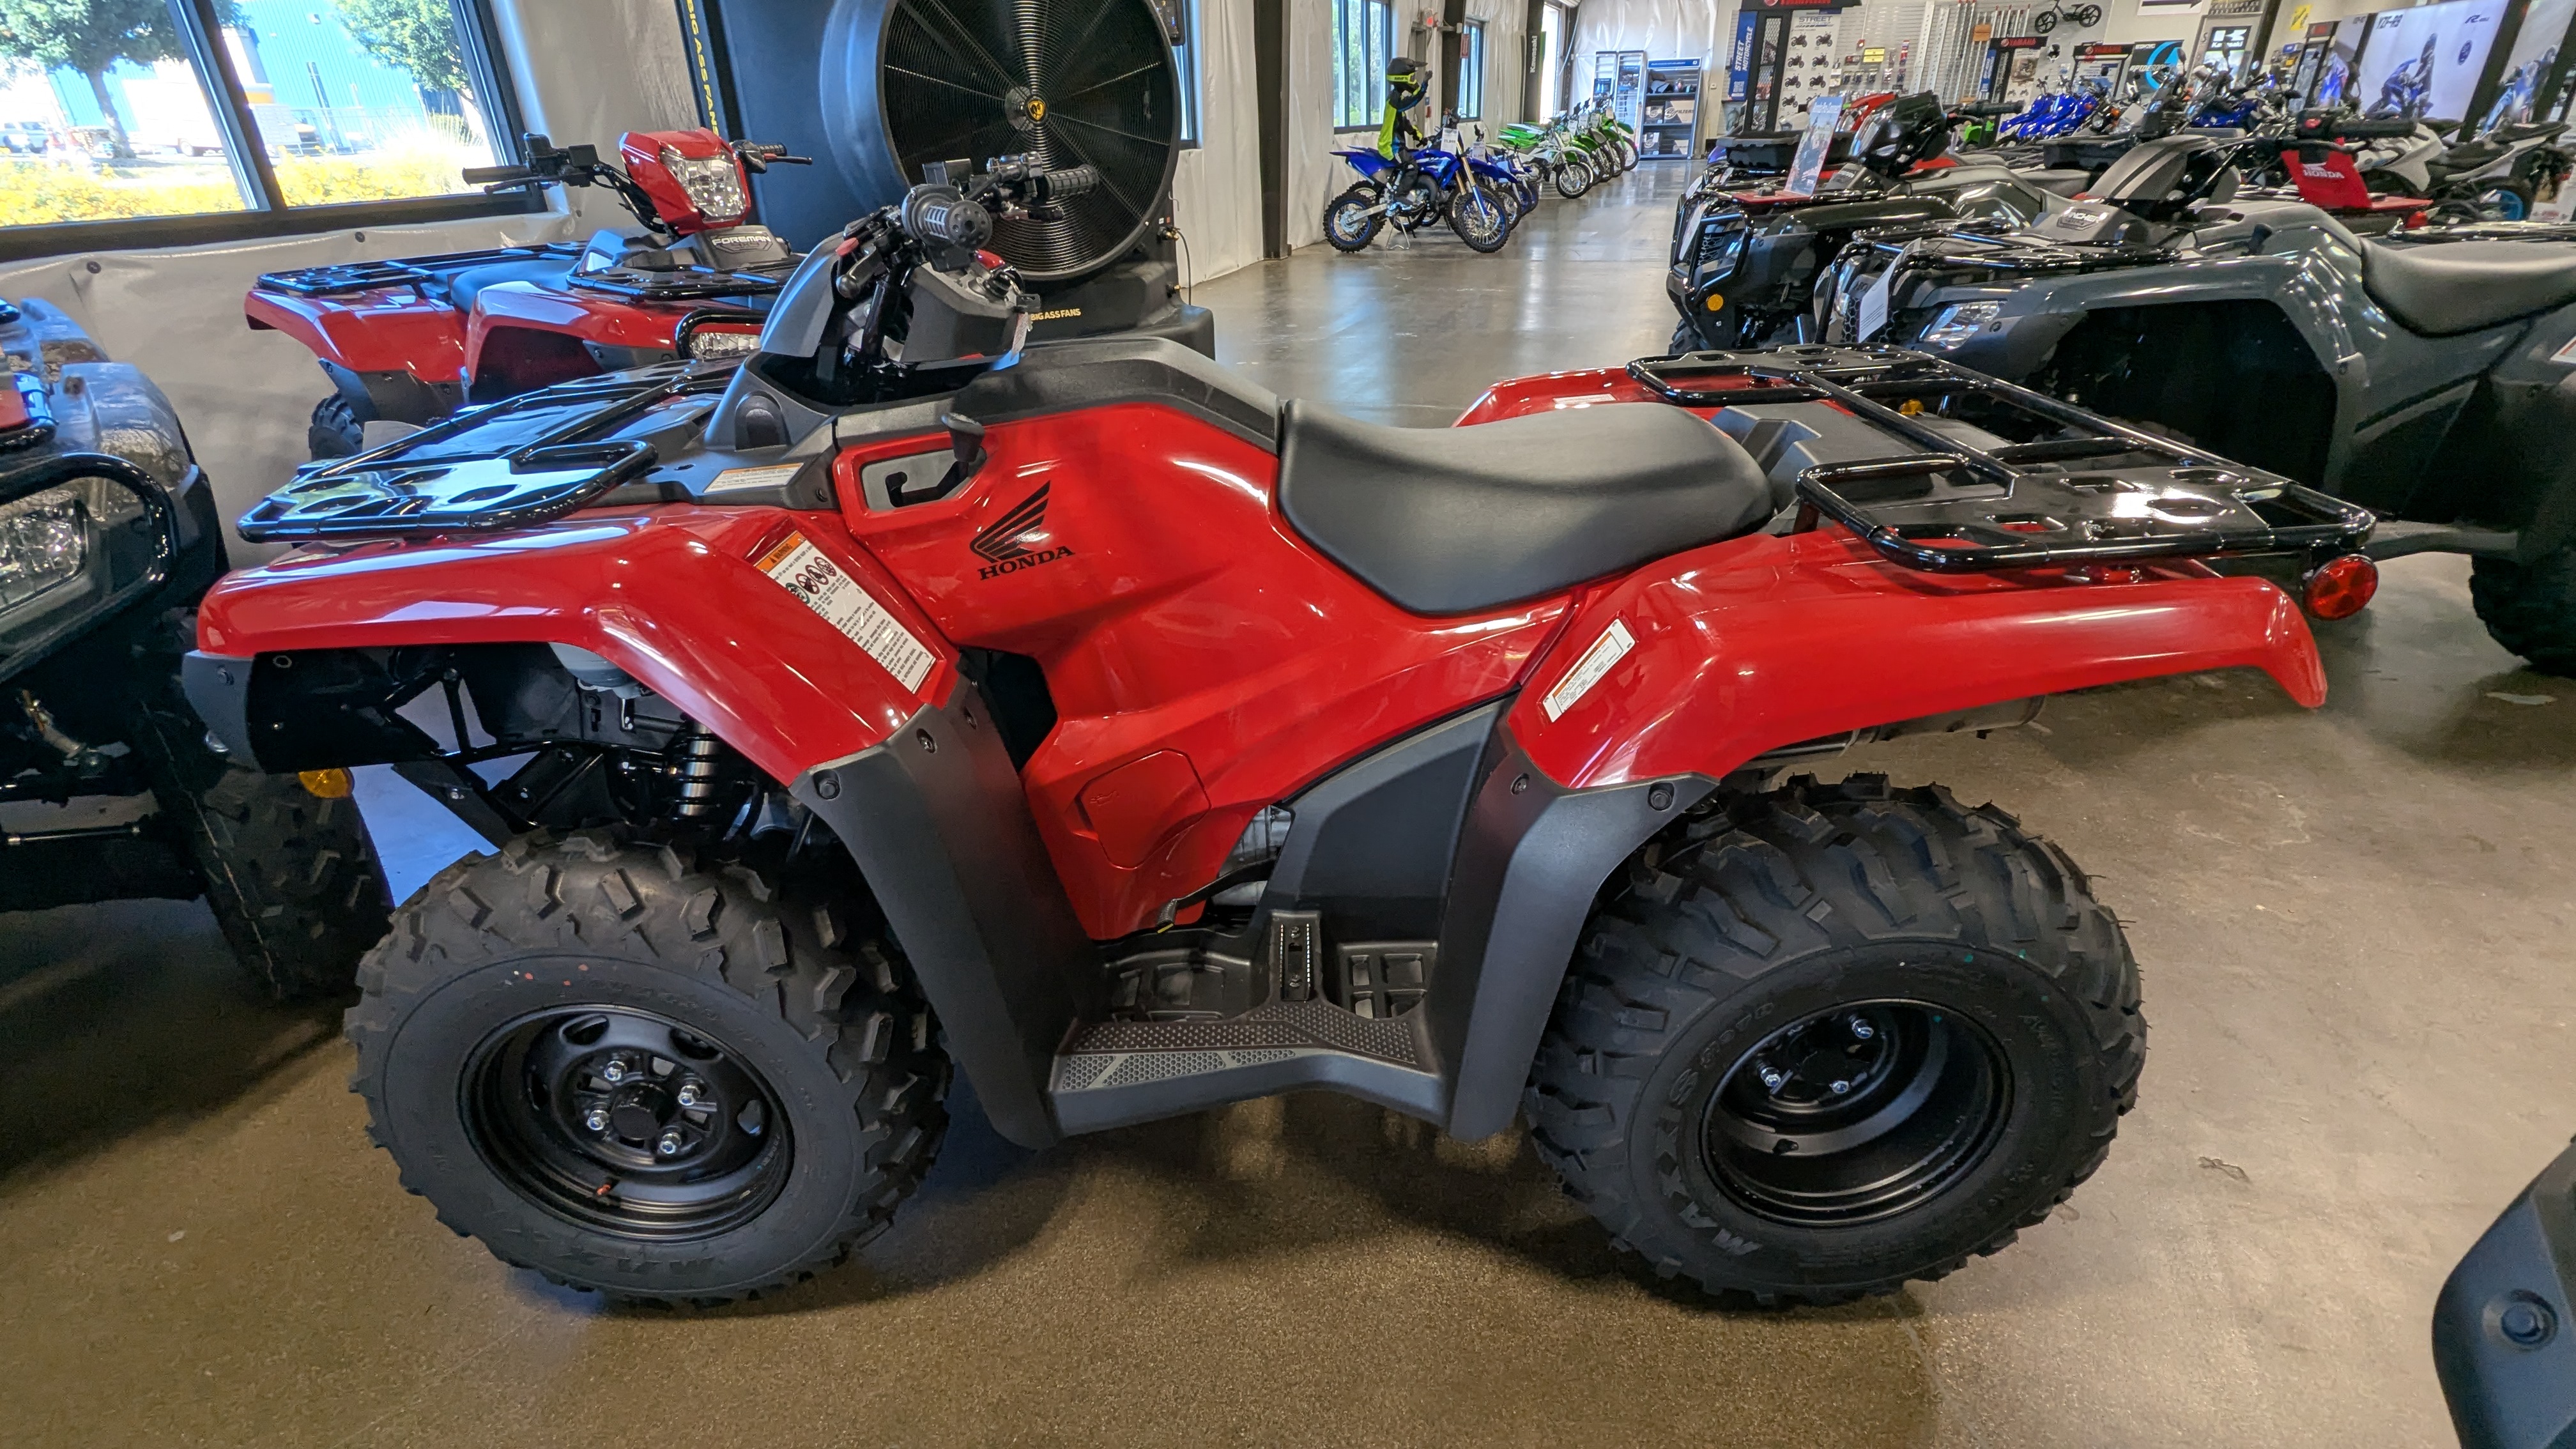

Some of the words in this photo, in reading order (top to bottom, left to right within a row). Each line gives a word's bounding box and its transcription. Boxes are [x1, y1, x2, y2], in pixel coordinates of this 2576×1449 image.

[1735, 40, 1744, 71] STREET
[1742, 26, 1753, 71] MOTORCYCLE
[687, 0, 699, 34] BIG
[694, 38, 708, 82] ASS
[703, 84, 719, 136] FANS
[712, 236, 770, 245] FOREMAN
[1031, 312, 1044, 321] BIG
[1044, 310, 1061, 319] ASS
[1061, 308, 1081, 318] FANS
[977, 546, 1075, 581] HONDA
